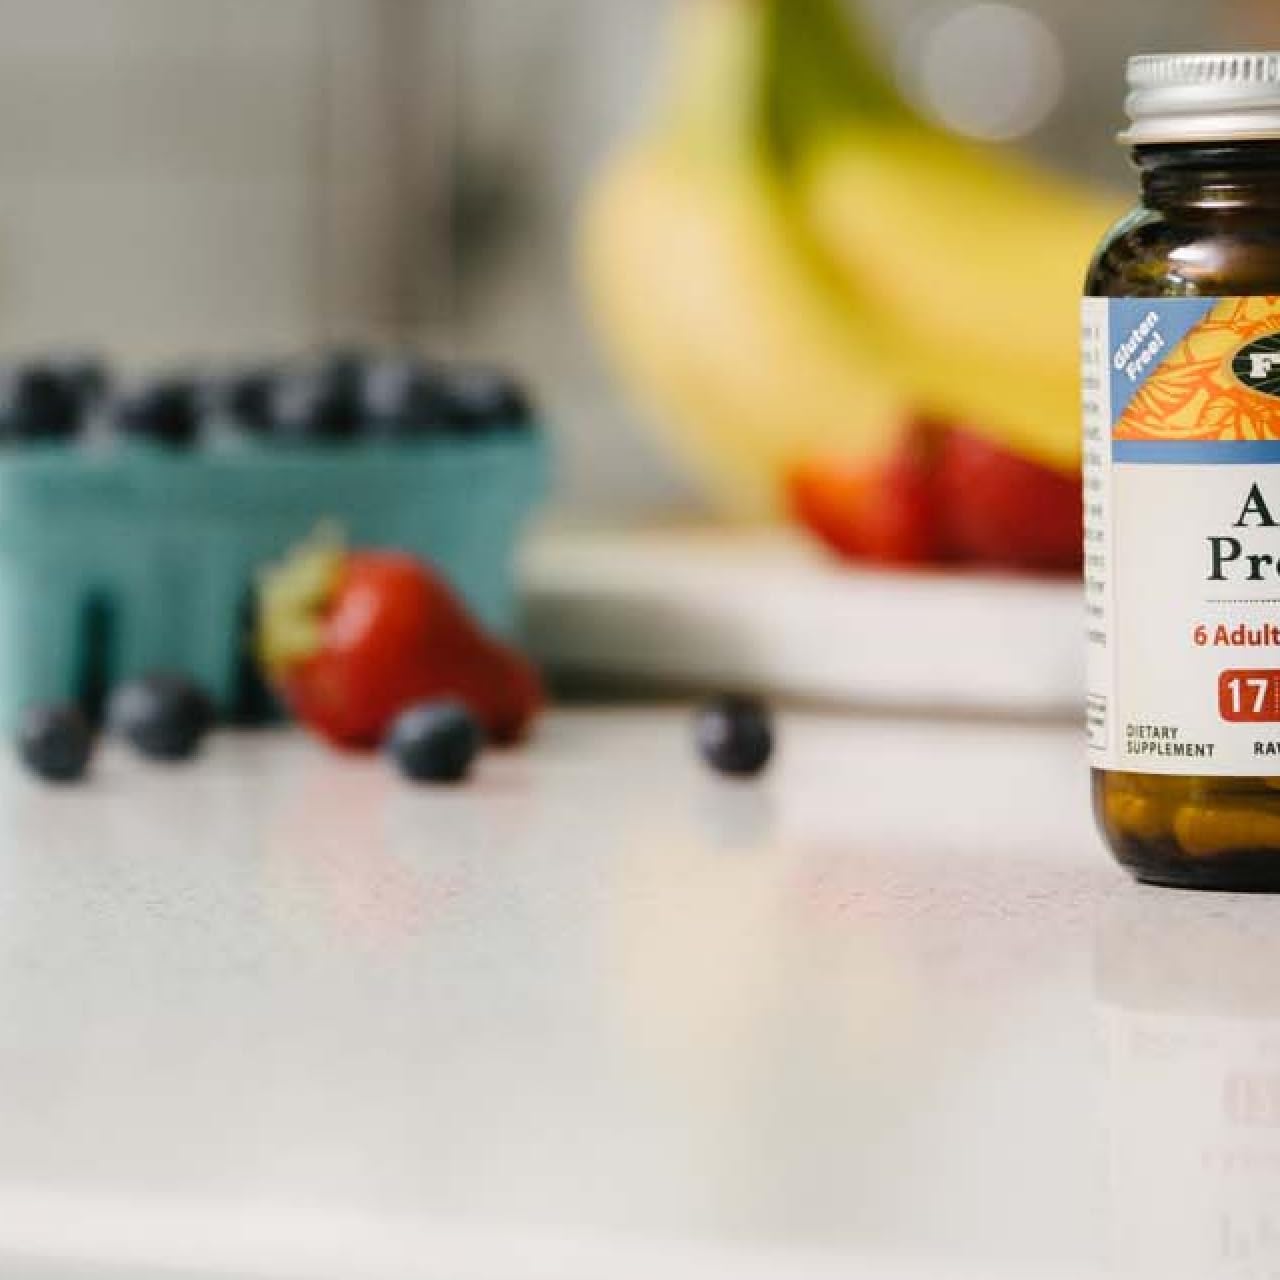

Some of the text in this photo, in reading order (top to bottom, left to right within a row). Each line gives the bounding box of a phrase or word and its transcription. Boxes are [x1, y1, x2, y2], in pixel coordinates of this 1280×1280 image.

[1113, 311, 1160, 370] Gluten
[1126, 331, 1165, 382] Free!
[1194, 624, 1208, 646] 6
[1227, 677, 1268, 713] 17
[1126, 724, 1178, 739] DIETARY
[1127, 741, 1215, 757] SUPPLEMENT
